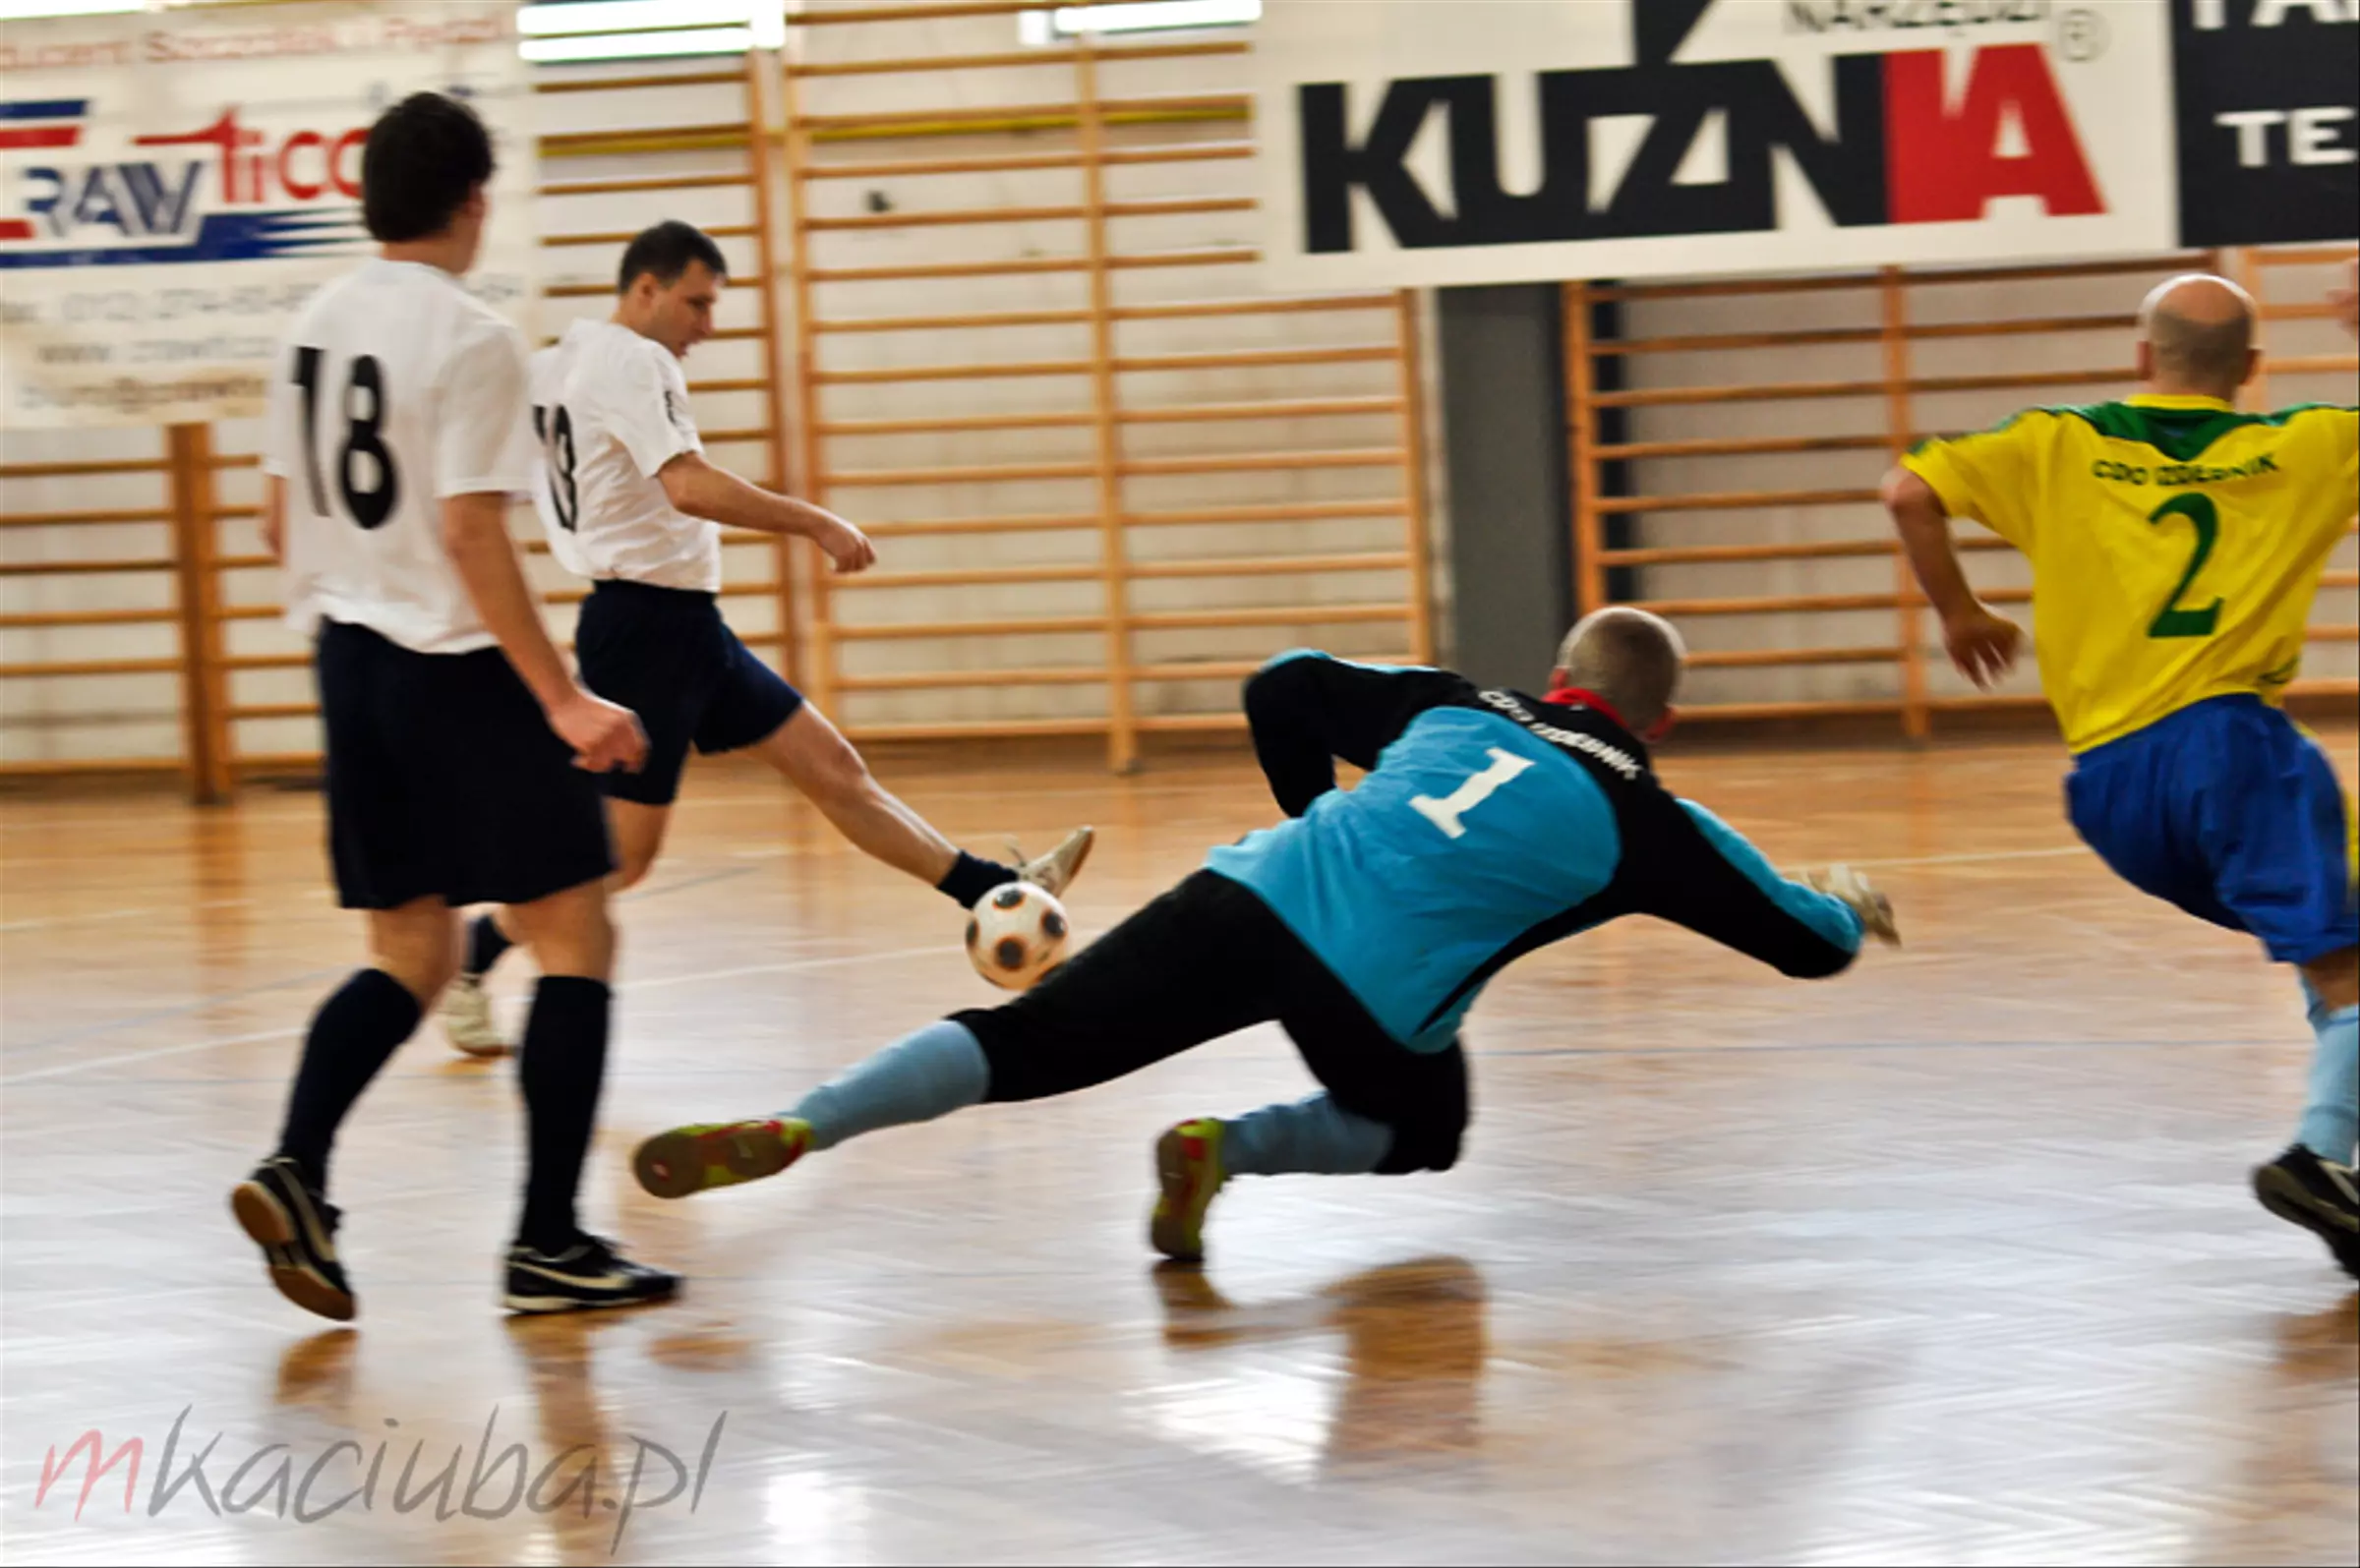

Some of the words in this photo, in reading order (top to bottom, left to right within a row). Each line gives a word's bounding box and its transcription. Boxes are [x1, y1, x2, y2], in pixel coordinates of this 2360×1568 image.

[291, 345, 401, 530] 18
[2147, 492, 2225, 639] 2
[1408, 746, 1536, 840] 1
